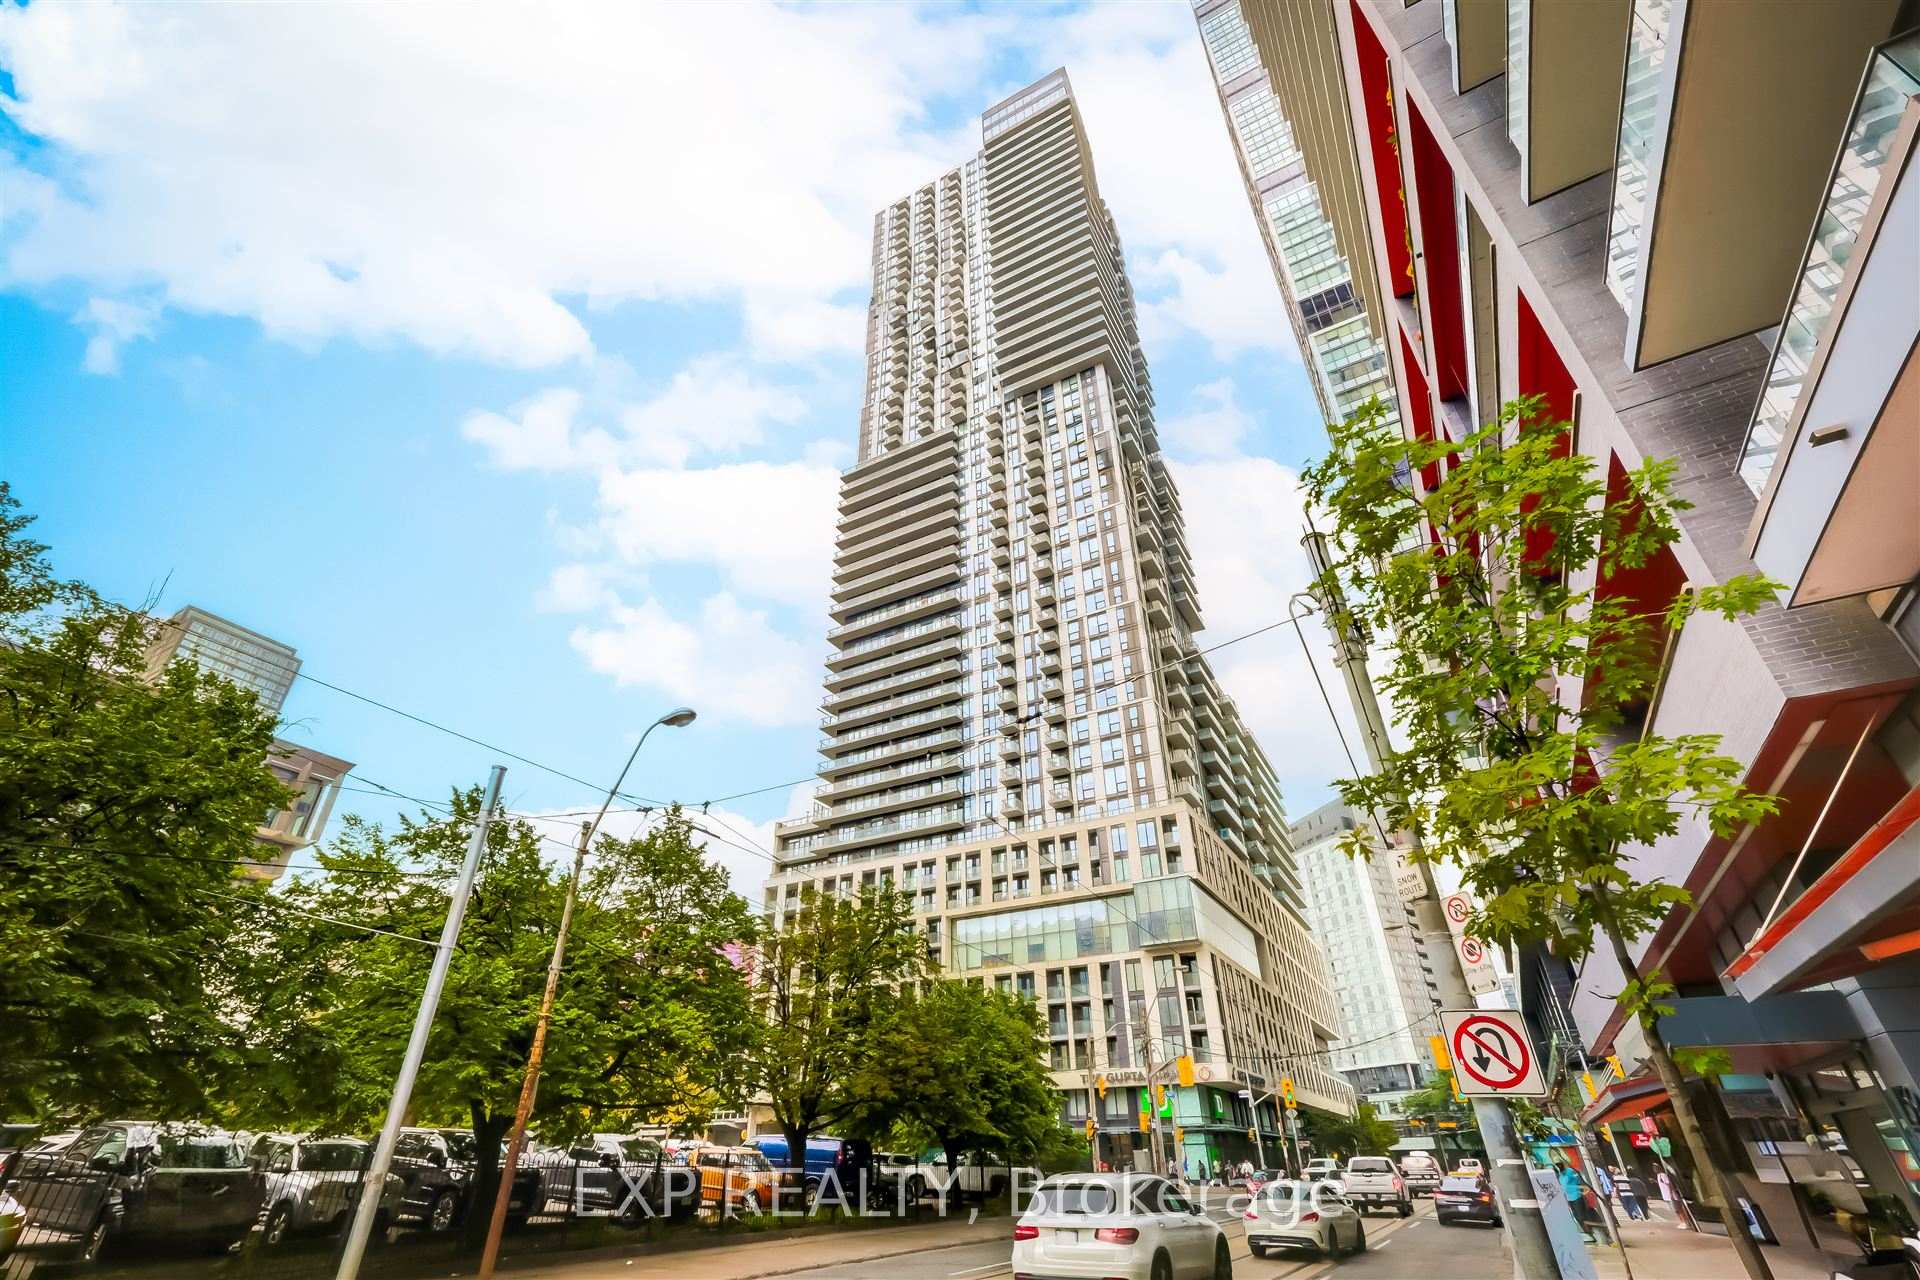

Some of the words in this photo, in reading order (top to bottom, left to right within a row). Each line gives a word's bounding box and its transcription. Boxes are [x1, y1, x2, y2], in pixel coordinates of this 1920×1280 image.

[1397, 872, 1418, 886] SNOW
[1399, 883, 1423, 897] ROUTE
[1106, 1071, 1146, 1084] GUPTA
